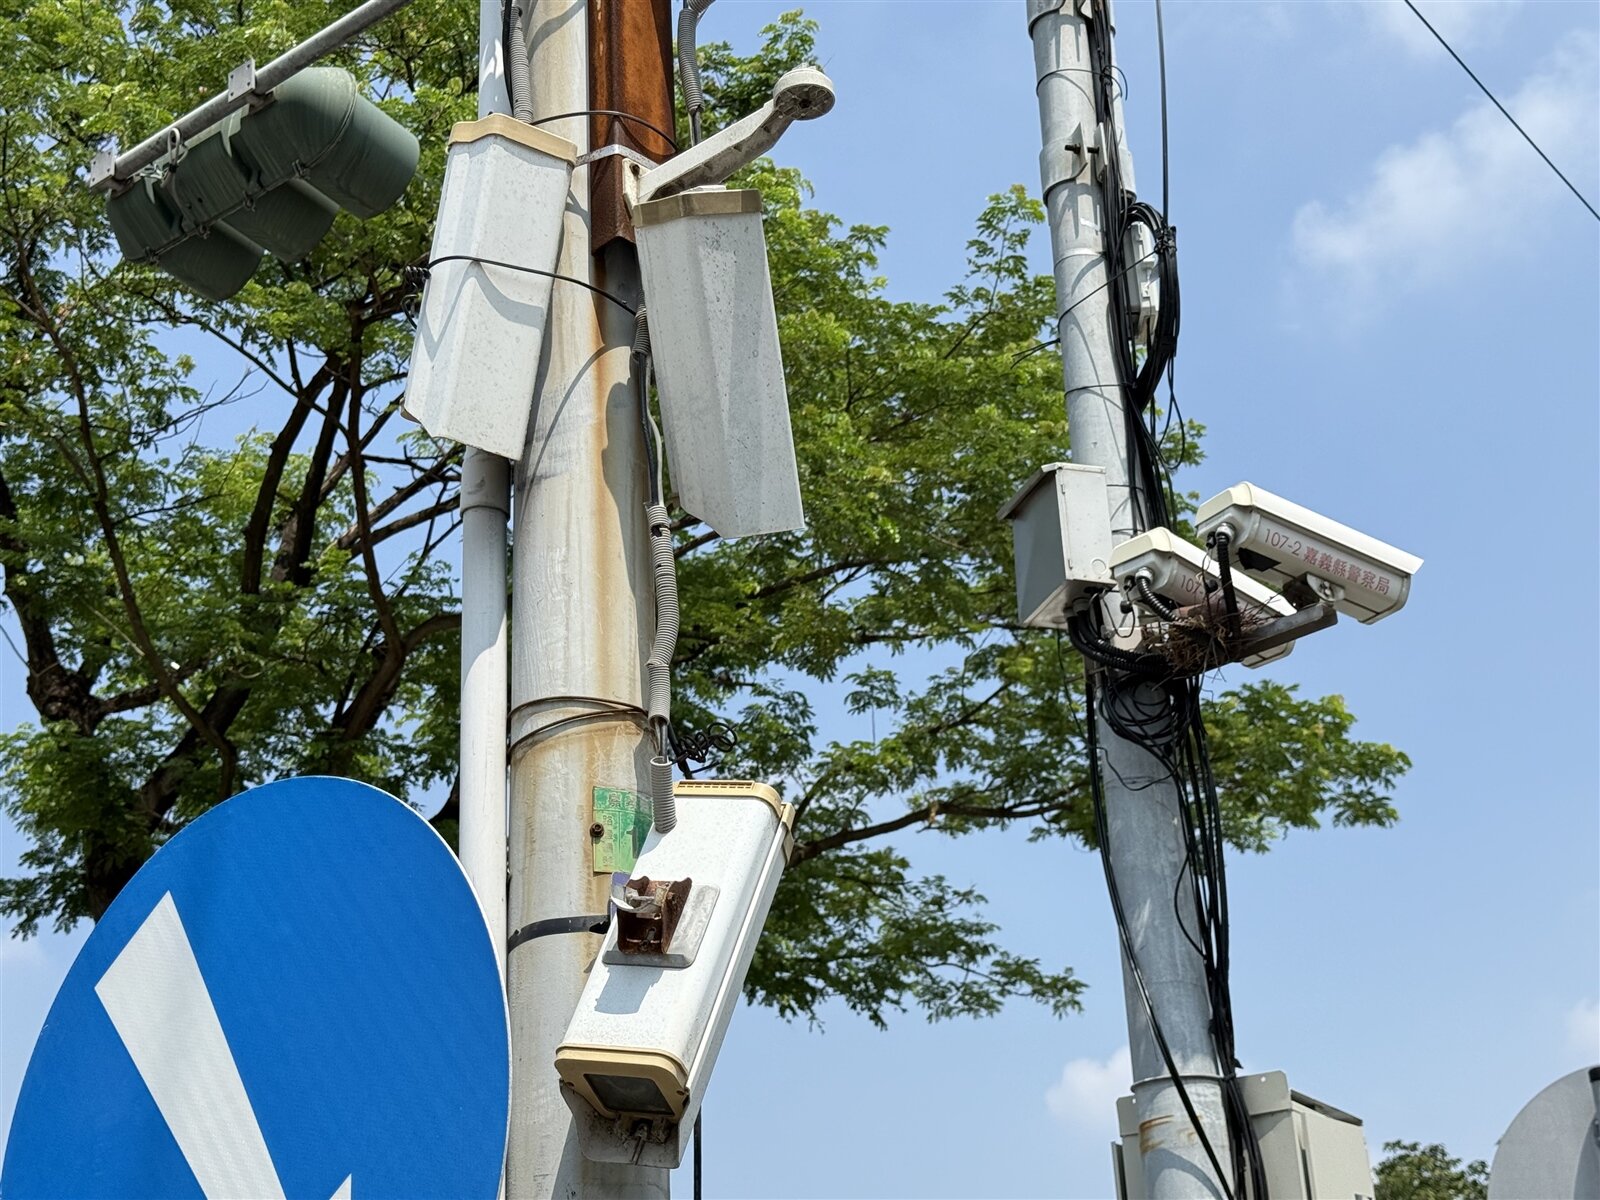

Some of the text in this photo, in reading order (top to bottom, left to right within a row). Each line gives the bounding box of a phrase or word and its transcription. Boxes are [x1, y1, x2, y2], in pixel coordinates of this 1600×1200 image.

[1264, 528, 1391, 595] 107-2 嘉義縣警察局
